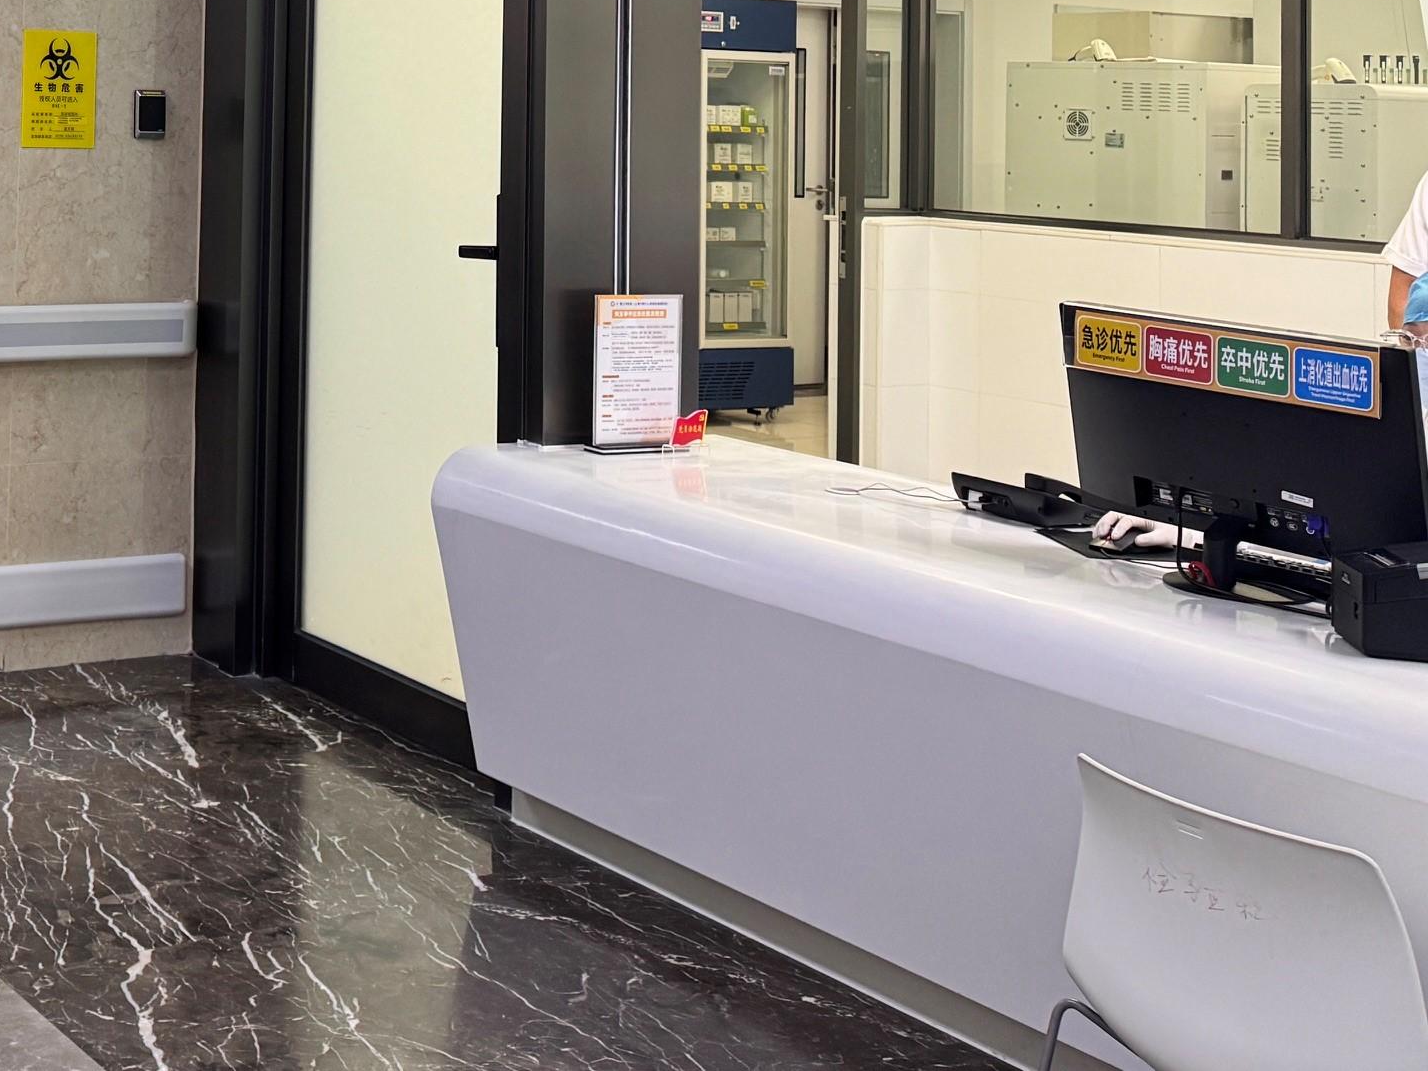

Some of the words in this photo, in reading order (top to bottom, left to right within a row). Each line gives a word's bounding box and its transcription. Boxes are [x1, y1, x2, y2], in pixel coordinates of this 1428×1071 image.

[34, 82, 84, 93] 生物危害
[1081, 324, 1137, 357] 急诊优先
[1148, 334, 1208, 369] 胸痛优先
[1221, 345, 1285, 380] 卒中优先
[1298, 357, 1368, 393] 上消化道出血优先
